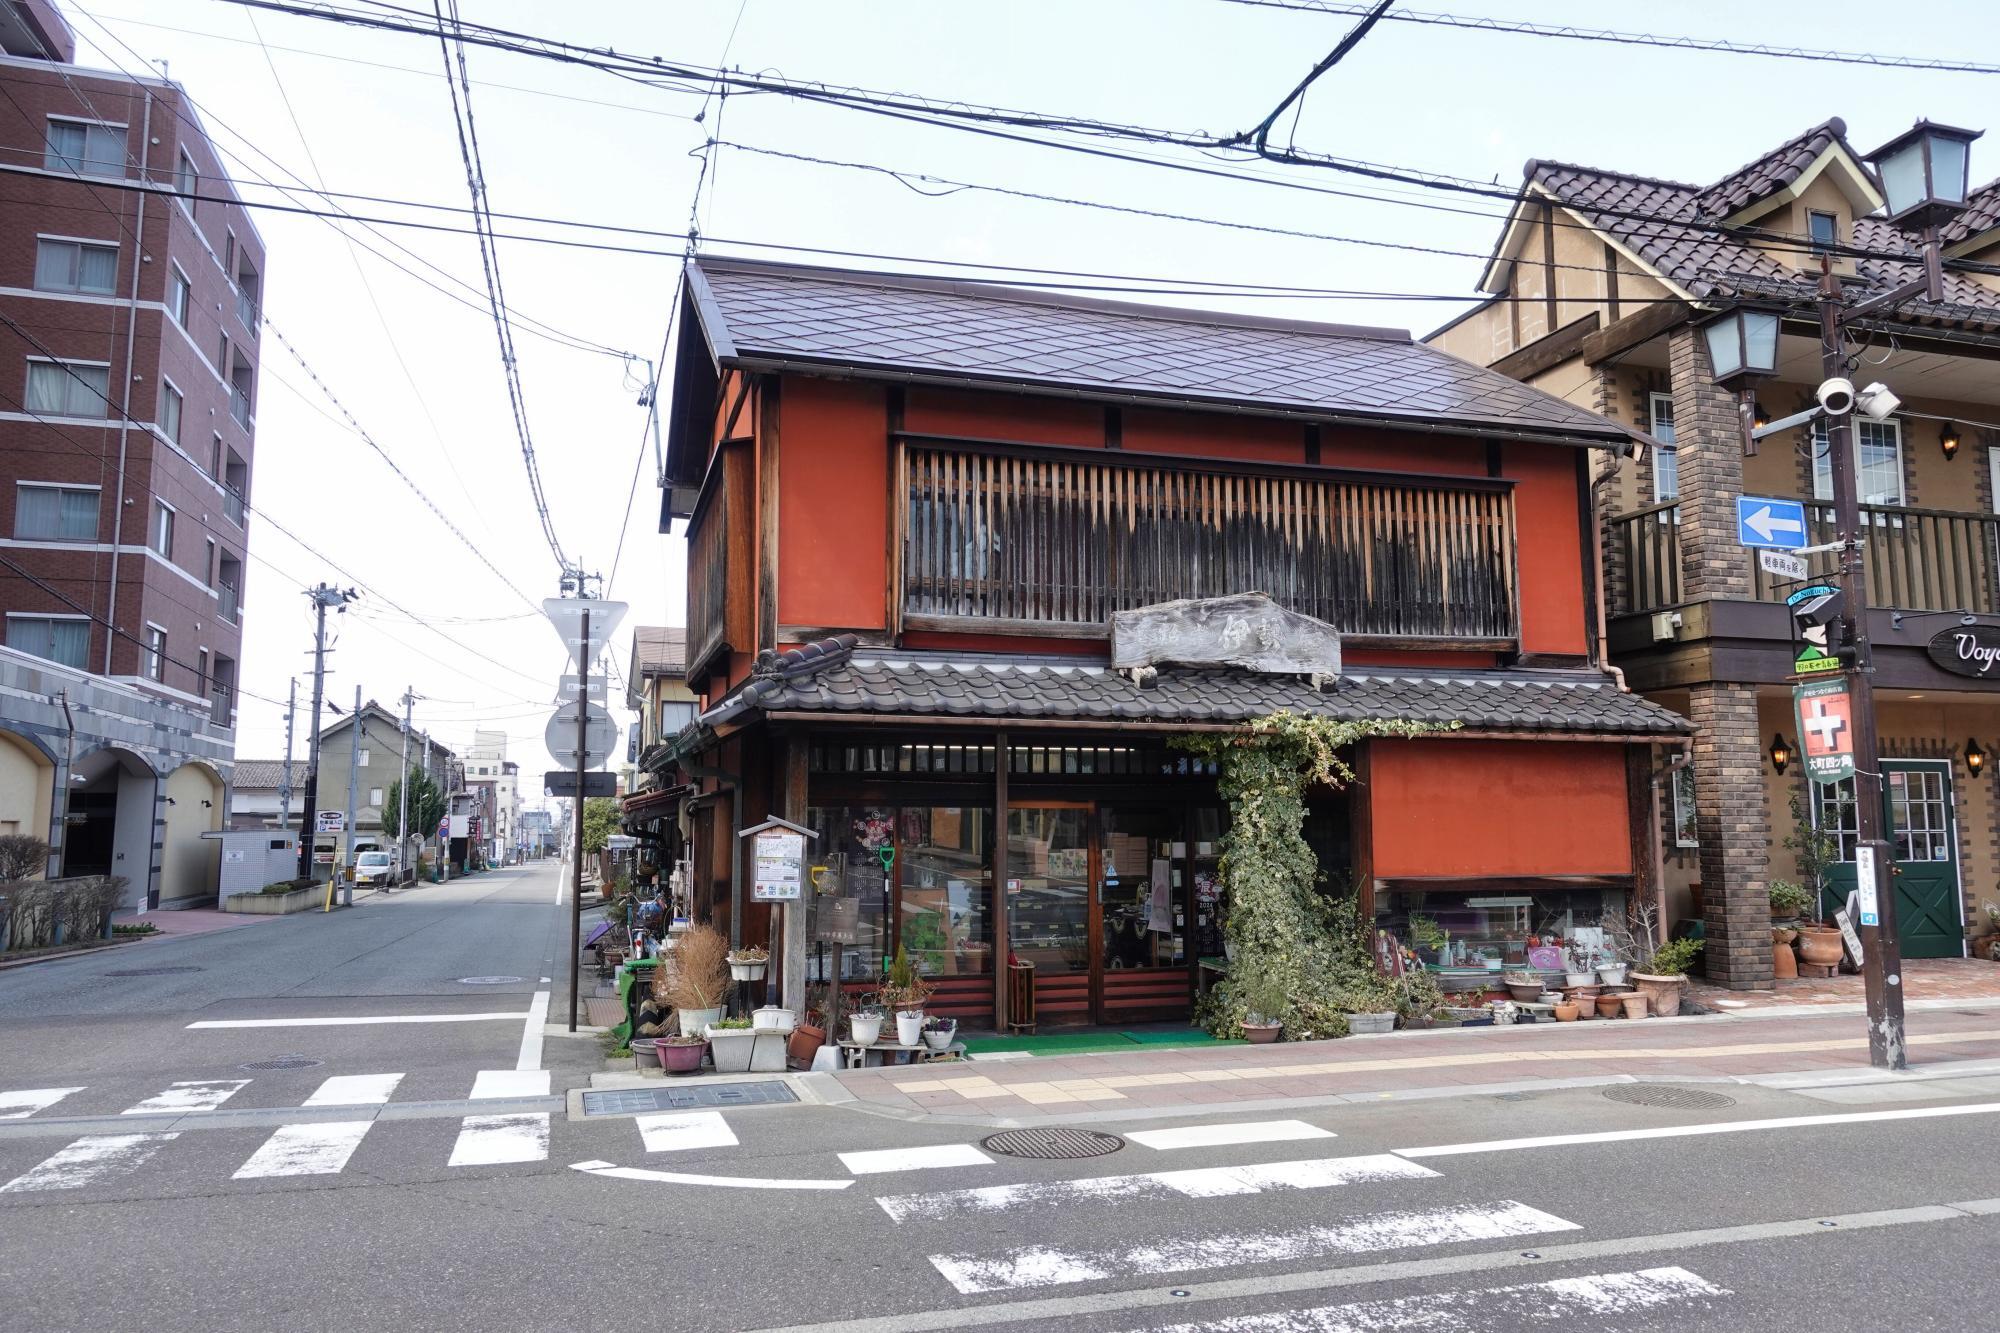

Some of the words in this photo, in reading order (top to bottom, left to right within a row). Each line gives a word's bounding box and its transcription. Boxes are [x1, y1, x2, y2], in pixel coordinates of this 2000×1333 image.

[1765, 556, 1804, 576] 軽車両を除く
[1809, 754, 1852, 770] 大町四ツ角
